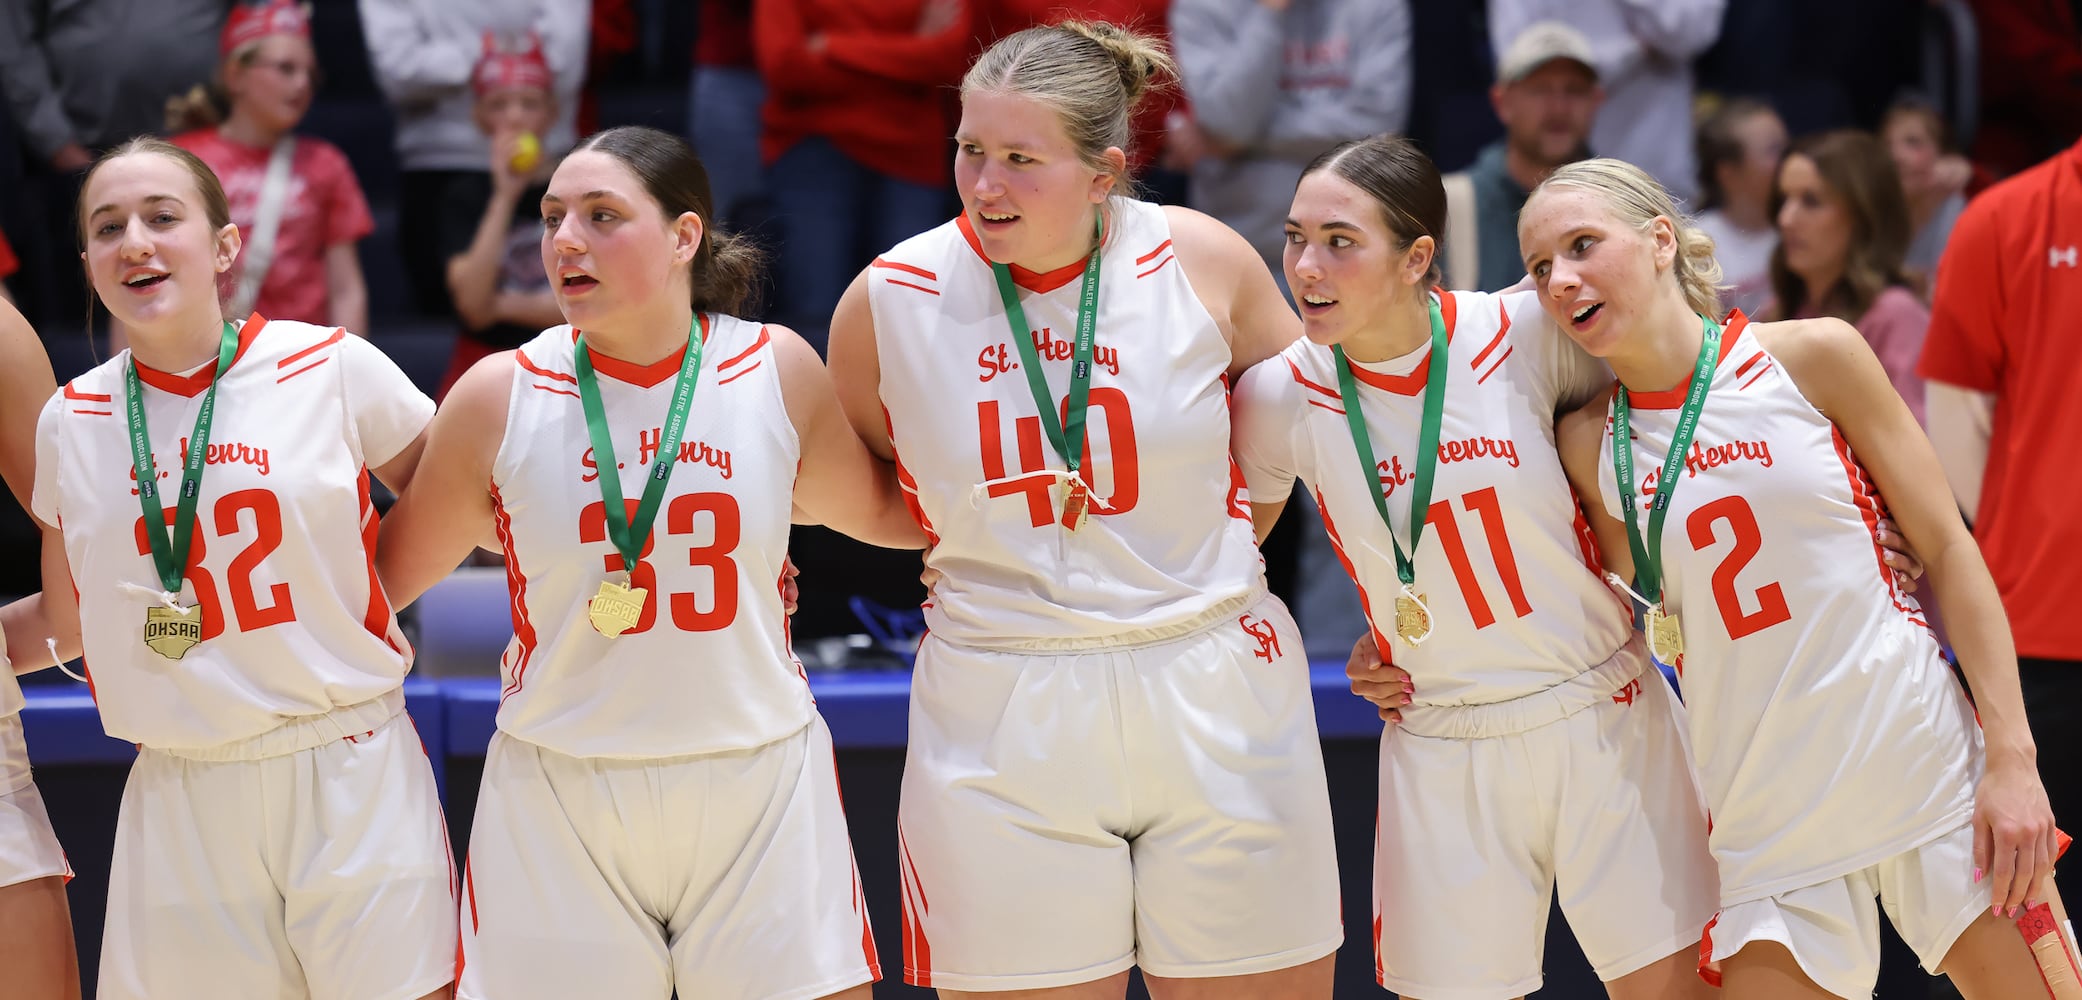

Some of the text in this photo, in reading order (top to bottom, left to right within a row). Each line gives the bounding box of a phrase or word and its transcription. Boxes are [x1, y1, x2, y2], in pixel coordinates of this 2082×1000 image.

[1085, 277, 1095, 306] ATHLETIC
[1080, 310, 1092, 351] ASSOCIATION
[684, 356, 697, 379] SCHOOL
[978, 344, 1018, 383] St.
[675, 382, 690, 411] ATHLETIC
[1690, 382, 1704, 406] SCHOOL
[131, 400, 141, 429] ATHLETIC
[663, 414, 682, 454] ASSOCIATION
[1679, 409, 1695, 439] ATHLETIC
[135, 432, 149, 472] ASSOCIATION
[190, 429, 206, 470] ASSOCIATION
[977, 387, 1139, 528] 40
[1619, 444, 1629, 484] ASSOCIATION
[1664, 442, 1684, 484] ASSOCIATION
[1684, 440, 1774, 478] Henry
[1374, 455, 1416, 499] St.
[134, 488, 297, 642] 32
[579, 492, 741, 635] 33
[1424, 486, 1534, 630] 11
[1686, 495, 1792, 641] 2
[148, 622, 199, 639] OHSAA
[593, 598, 641, 623] OHSAA
